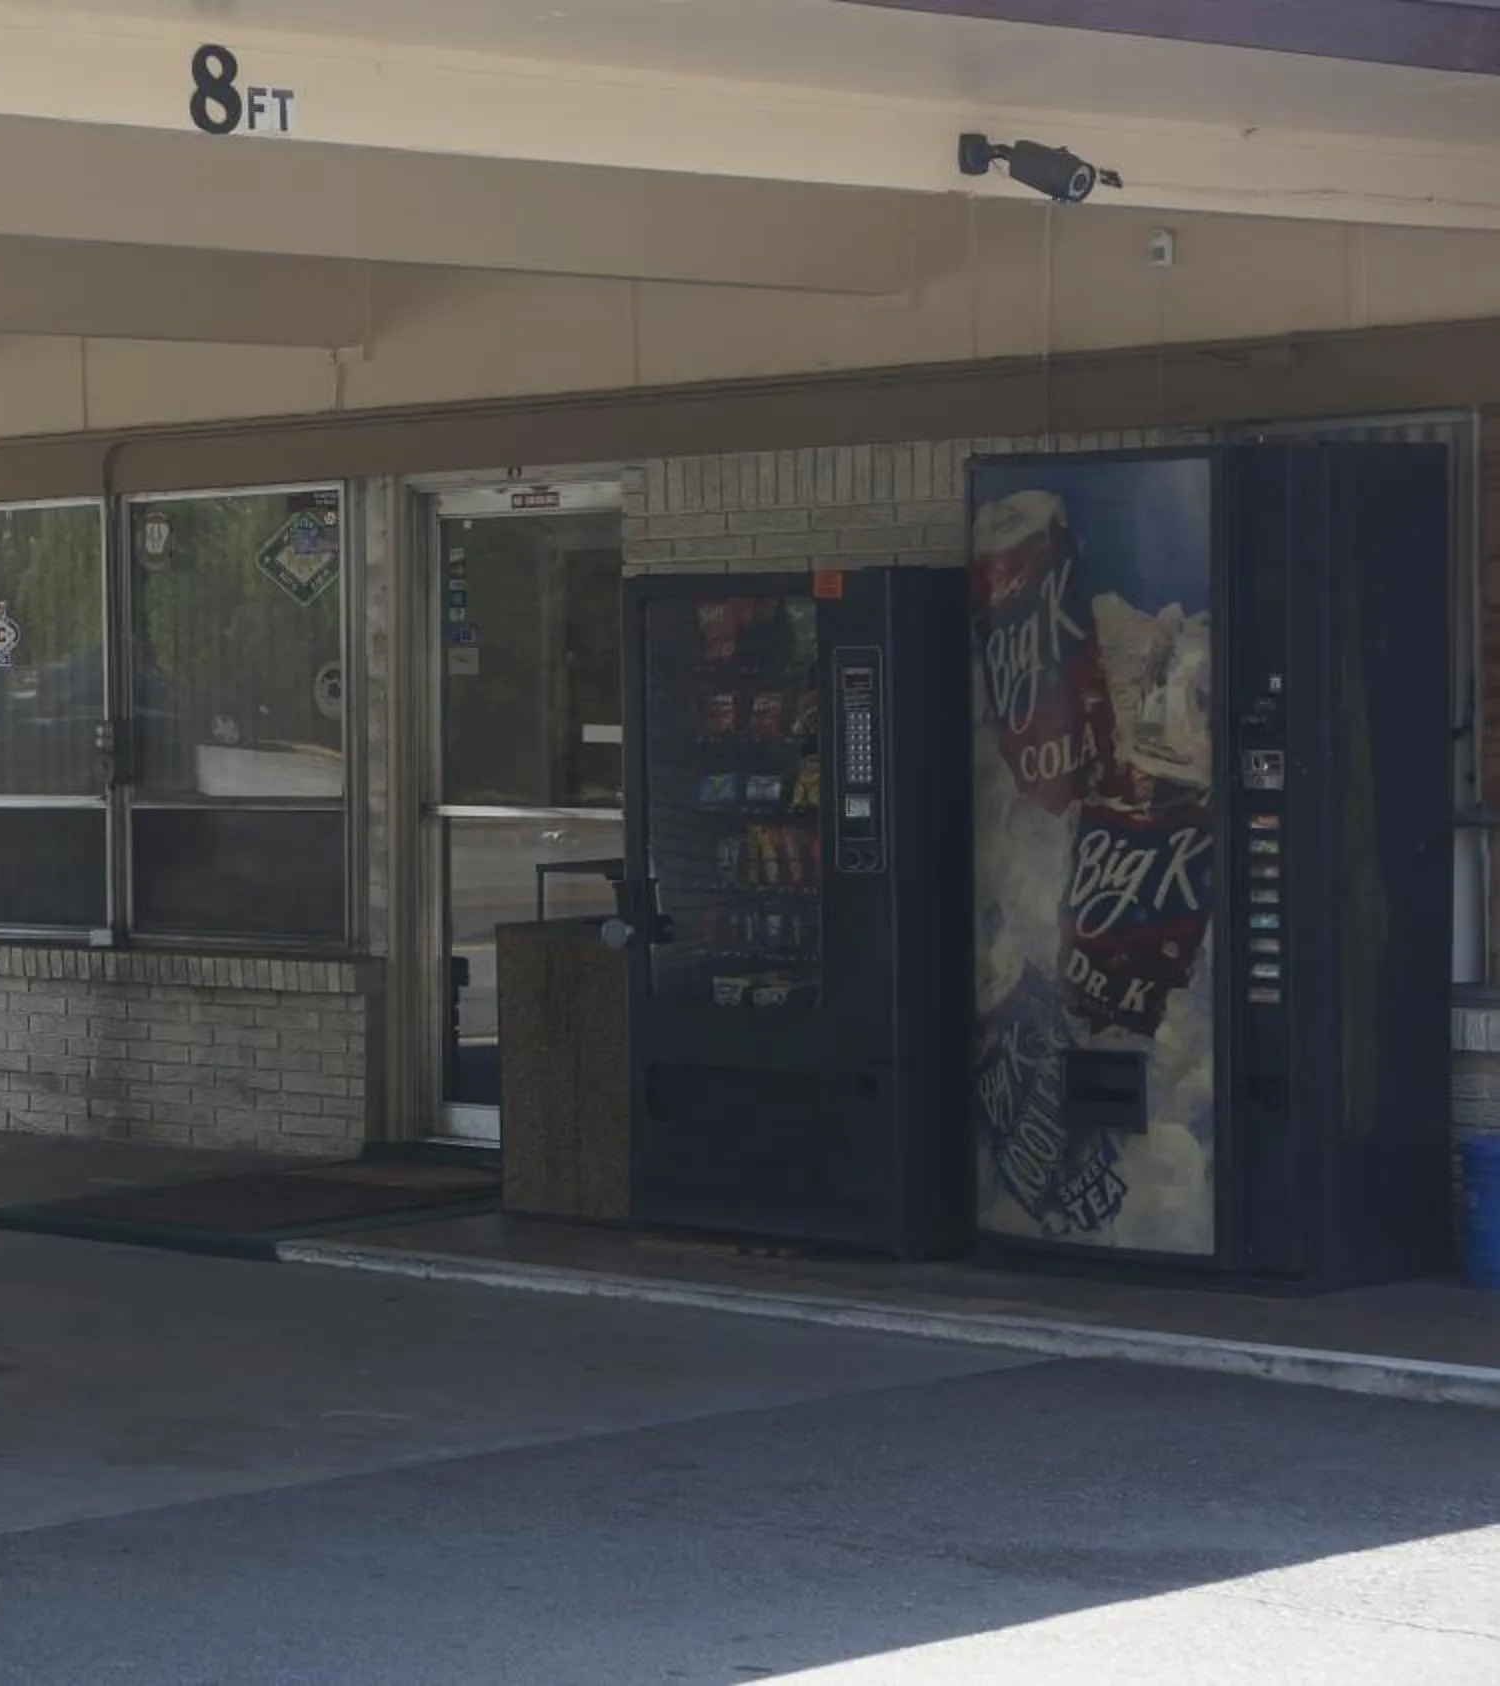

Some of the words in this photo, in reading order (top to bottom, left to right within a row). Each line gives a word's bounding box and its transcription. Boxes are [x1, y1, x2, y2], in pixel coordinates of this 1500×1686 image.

[190, 43, 242, 135] 8
[247, 86, 295, 132] FT
[986, 610, 1045, 735] Big
[1039, 558, 1087, 664] K
[1019, 720, 1098, 782] COLA
[1068, 828, 1159, 939] Big
[1152, 827, 1215, 911] K
[1064, 947, 1110, 1003] DR.
[1118, 977, 1155, 1012] K
[1064, 1171, 1123, 1229] TEA
